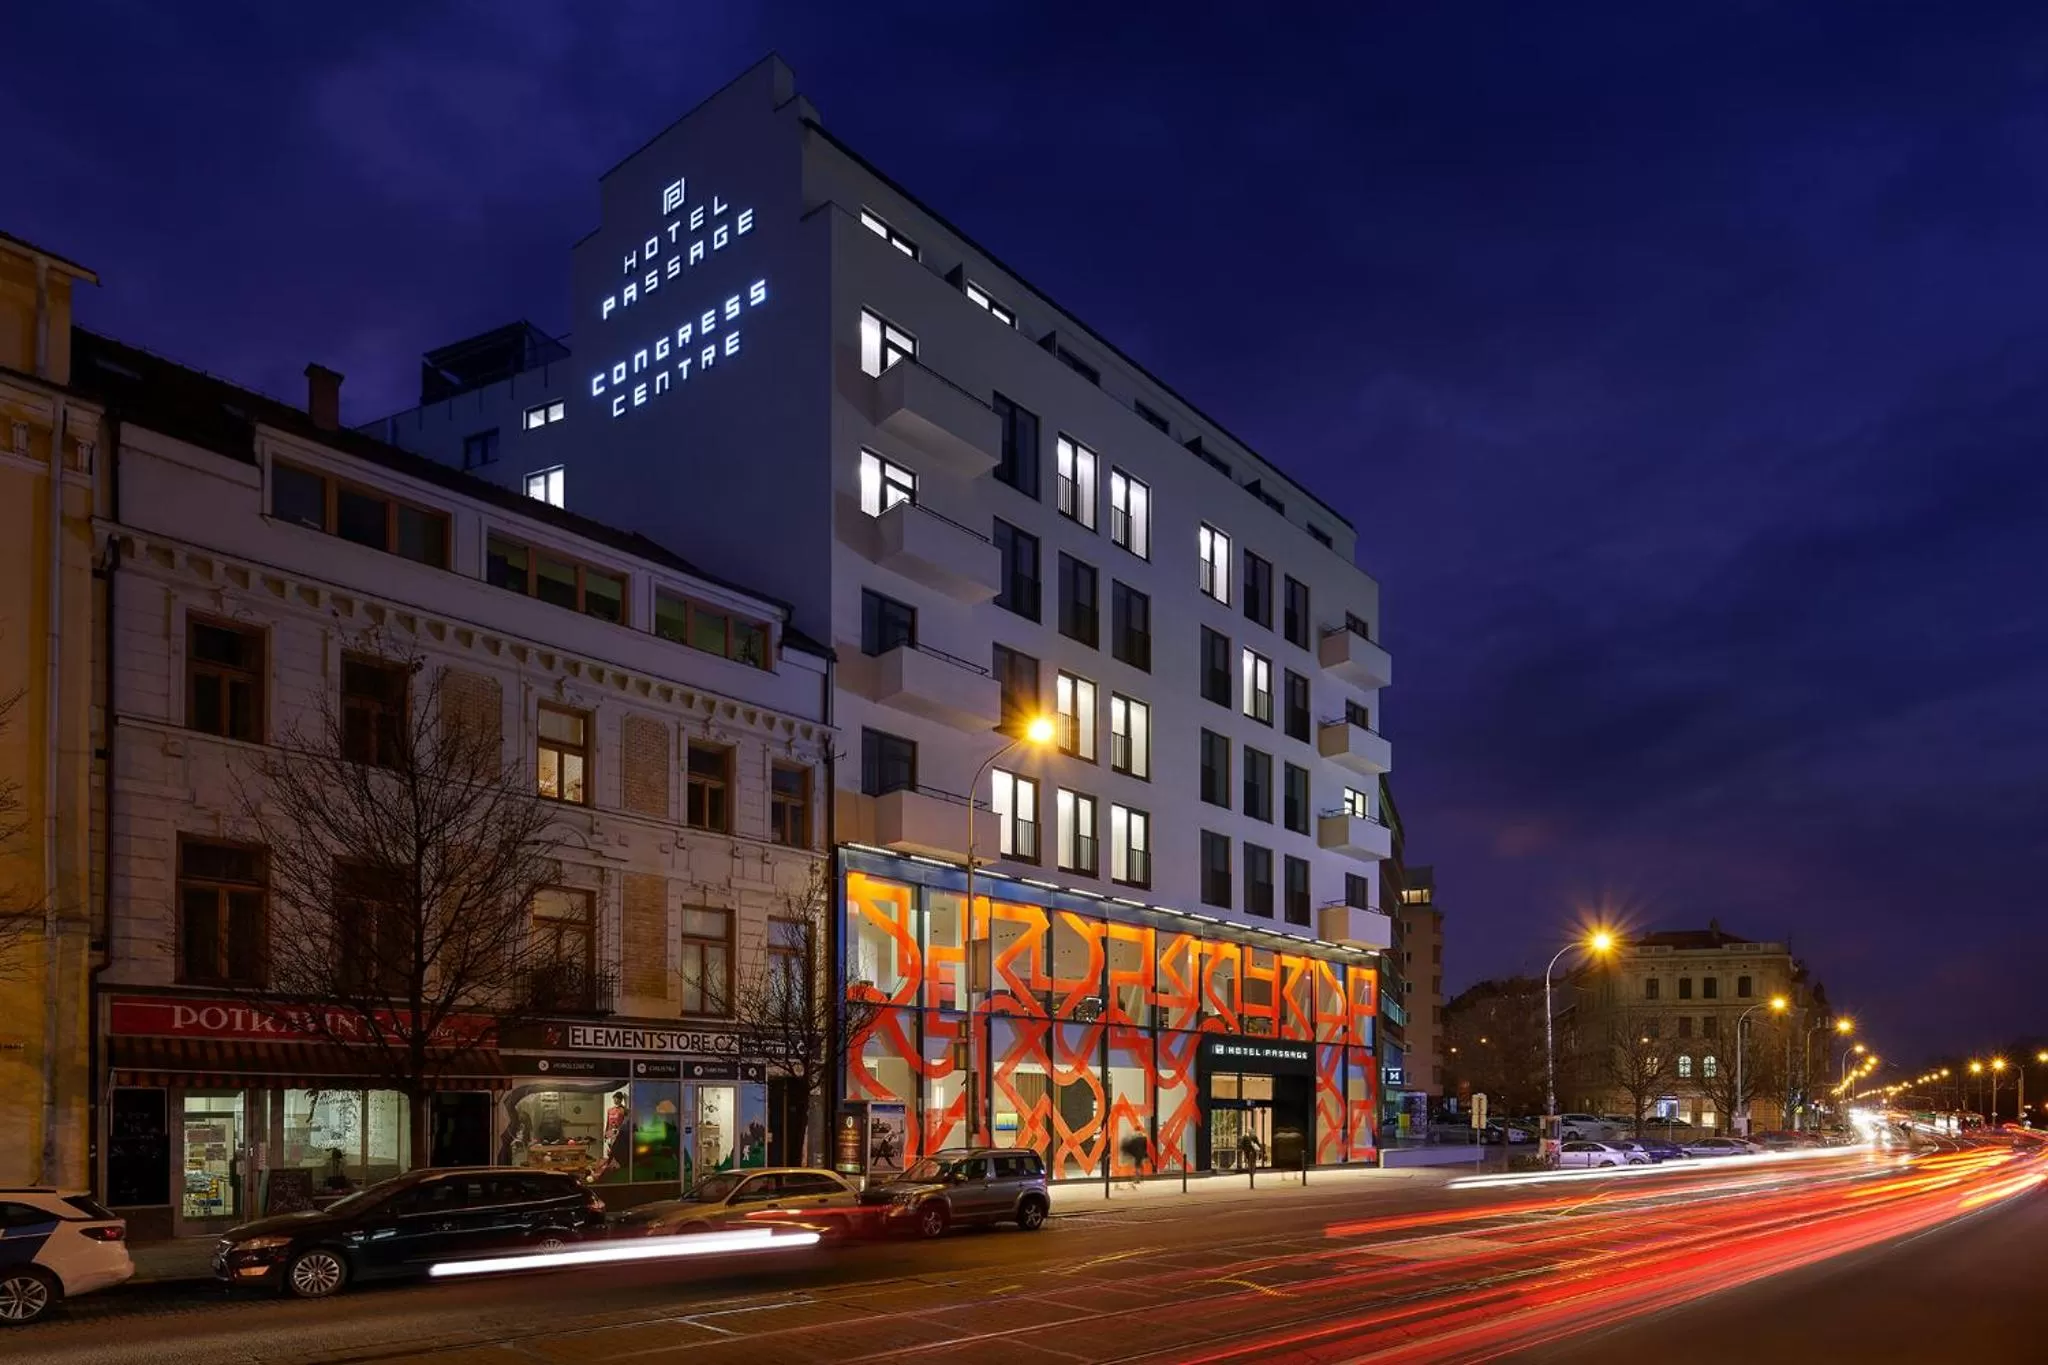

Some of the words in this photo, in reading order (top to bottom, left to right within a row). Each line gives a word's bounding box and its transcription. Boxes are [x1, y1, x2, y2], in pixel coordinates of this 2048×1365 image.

[602, 208, 753, 320] PASSAGE
[624, 196, 728, 274] HOTEL
[591, 279, 766, 397] CONGRESS
[612, 331, 740, 418] CENTRE
[571, 1028, 736, 1052] ELEMENTSTORE.CZ
[1228, 1046, 1261, 1056] HOTEL
[1264, 1049, 1308, 1060] PASSAGE
